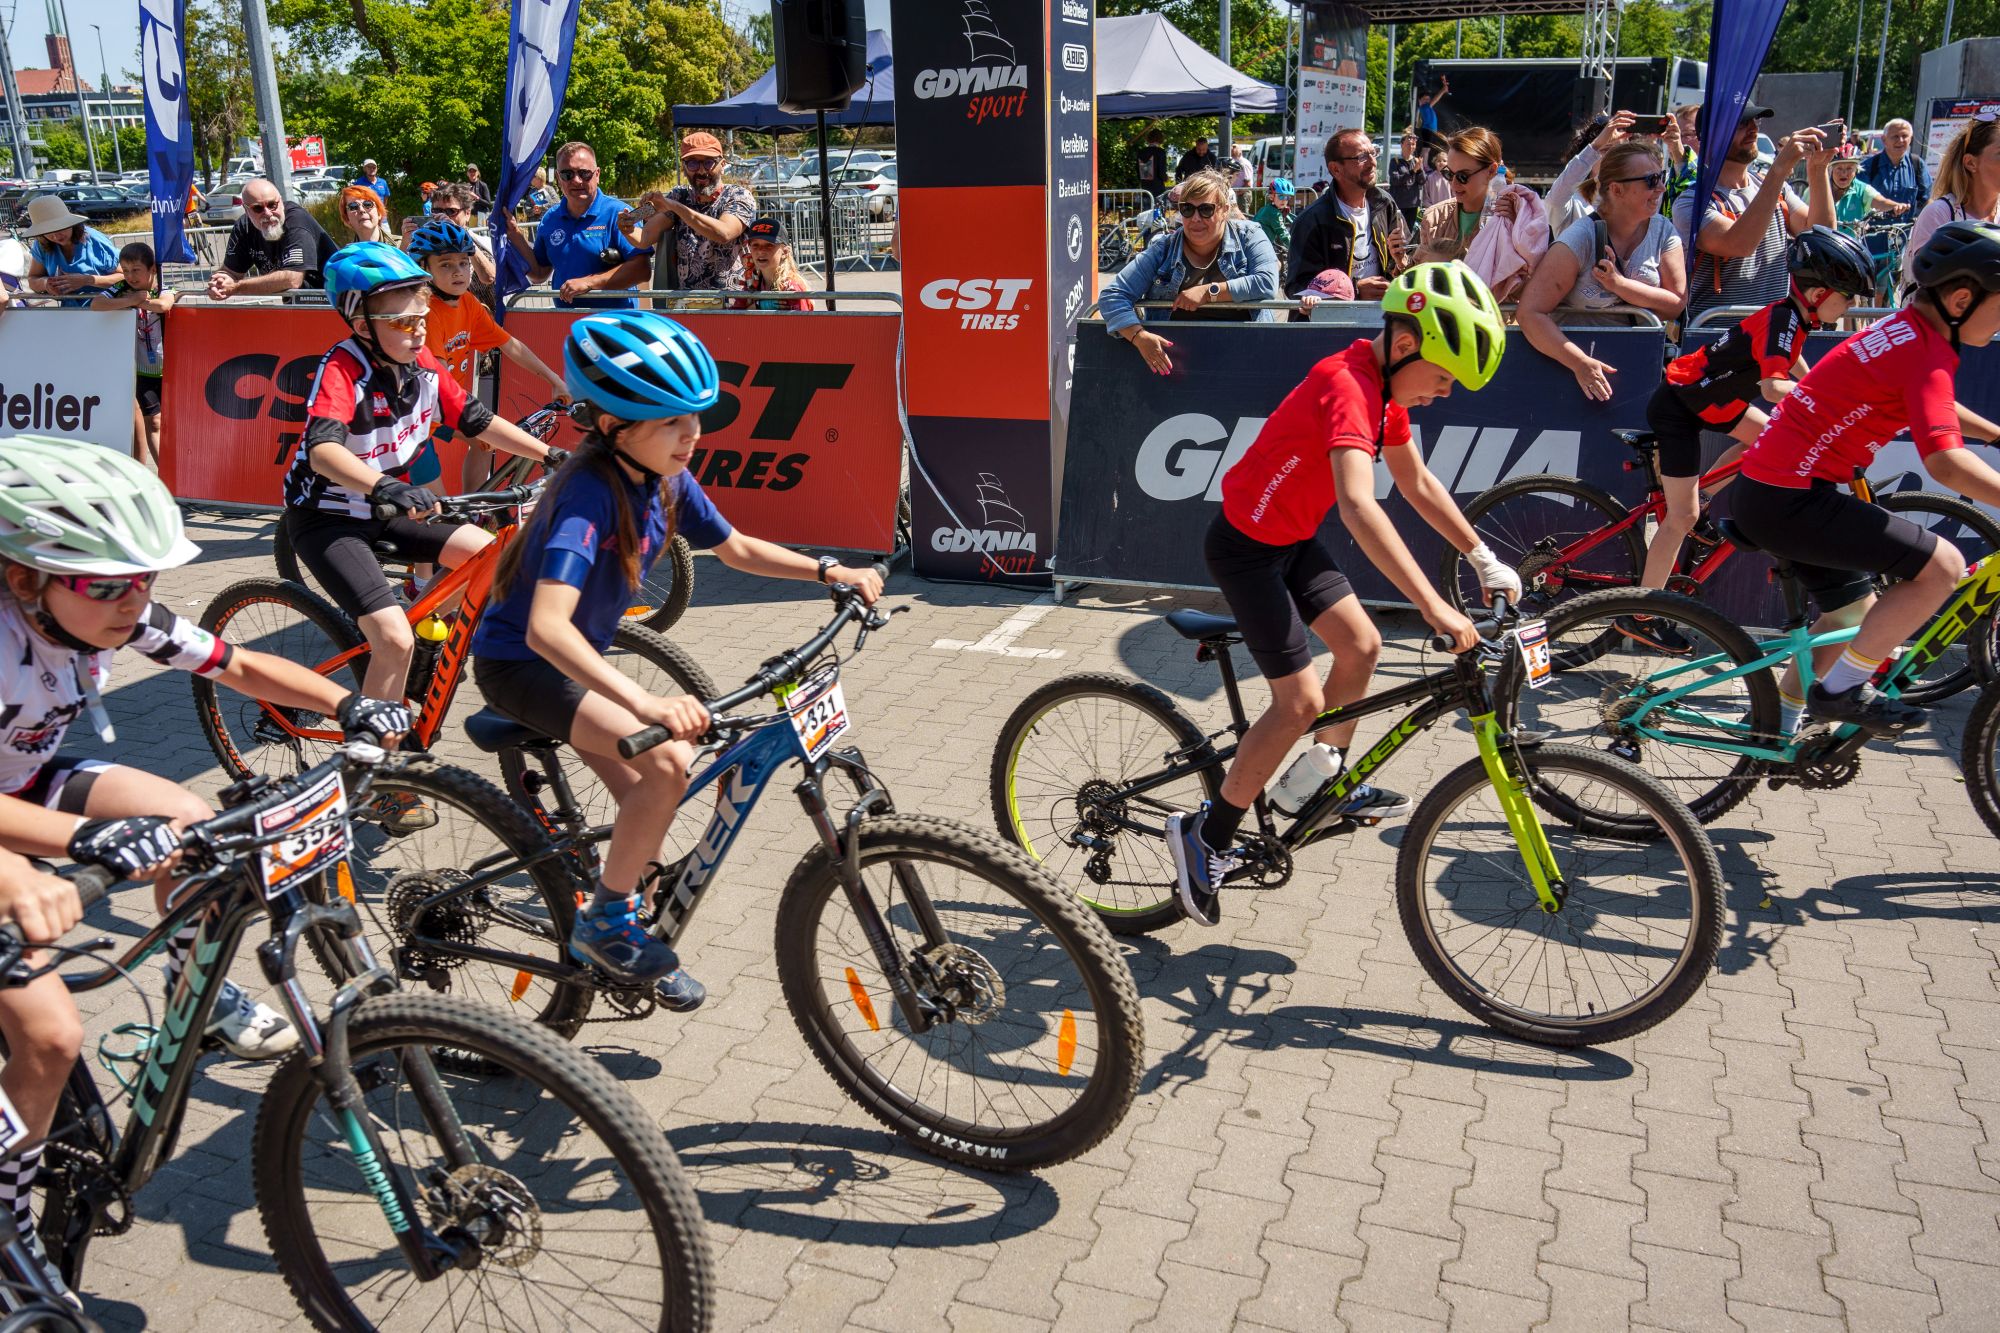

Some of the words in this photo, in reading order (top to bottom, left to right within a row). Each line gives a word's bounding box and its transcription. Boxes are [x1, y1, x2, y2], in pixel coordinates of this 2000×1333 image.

[1065, 49, 1085, 65] ABUS
[913, 64, 1028, 100] GDYNIA
[966, 90, 1028, 126] sport
[1067, 99, 1091, 112] B-Active
[1058, 178, 1091, 198] BatekLife
[919, 278, 1034, 311] CST
[1065, 275, 1084, 319] BORN
[960, 313, 1020, 331] TIRES
[205, 353, 322, 423] CS
[706, 361, 856, 441] ST
[1251, 455, 1301, 524] AGAPATOKA.COM
[931, 526, 1037, 553] GDYNIA
[979, 553, 1035, 579] sport
[807, 694, 836, 730] 321
[1328, 714, 1419, 799] TREK
[653, 763, 757, 938] TREK
[134, 898, 222, 1127] TREK
[917, 1126, 1008, 1160] MAXXIS
